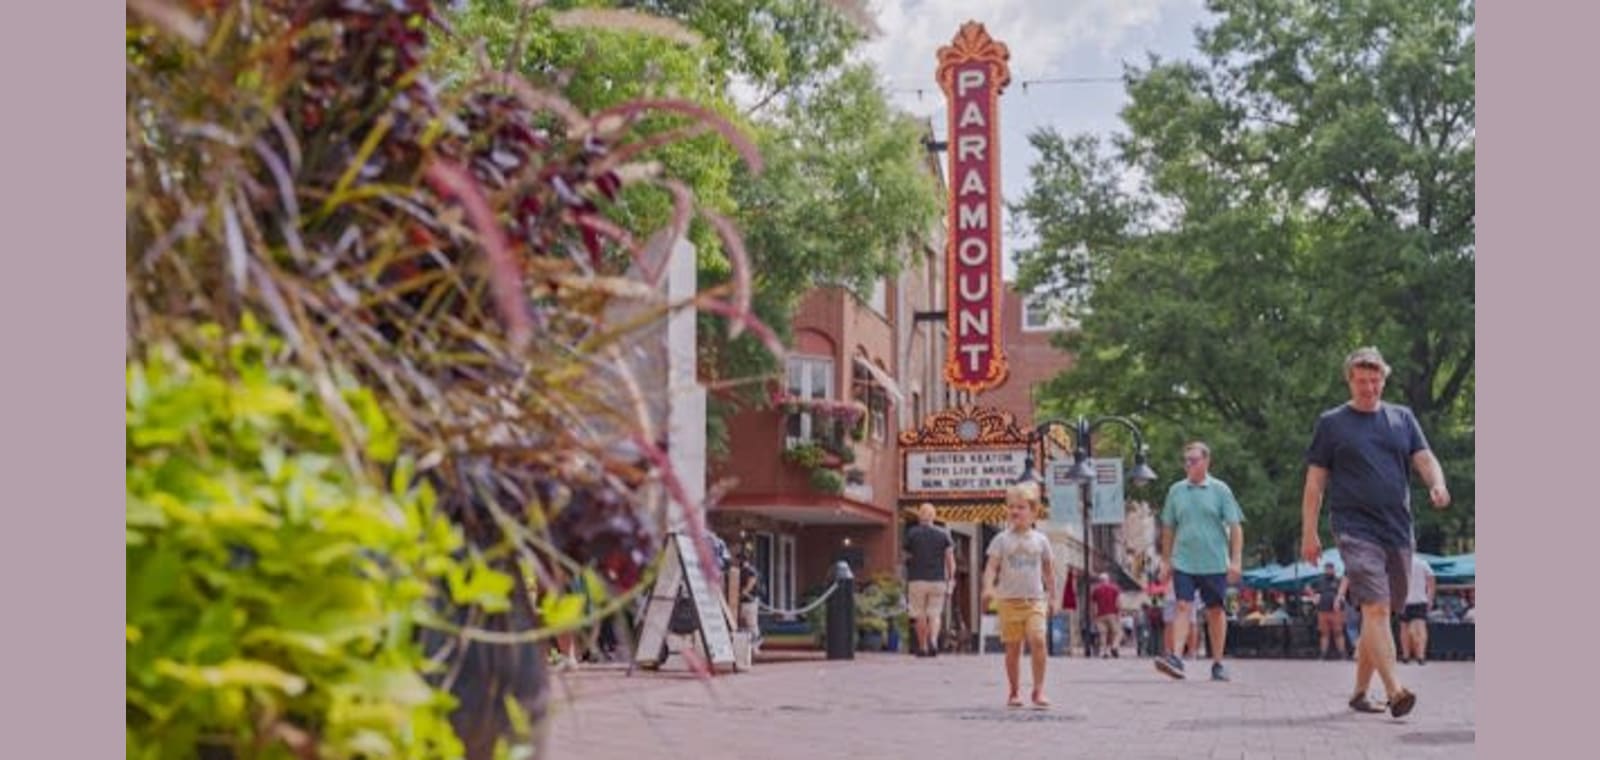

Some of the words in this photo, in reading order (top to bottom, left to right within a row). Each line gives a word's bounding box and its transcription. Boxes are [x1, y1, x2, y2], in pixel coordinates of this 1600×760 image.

[958, 70, 988, 372] PARAMOUNT
[926, 454, 965, 463] BUSTER
[970, 453, 1012, 462] KEATON
[922, 467, 949, 475] WITH
[953, 467, 977, 475] LIVE
[982, 465, 1017, 475] MUSIC
